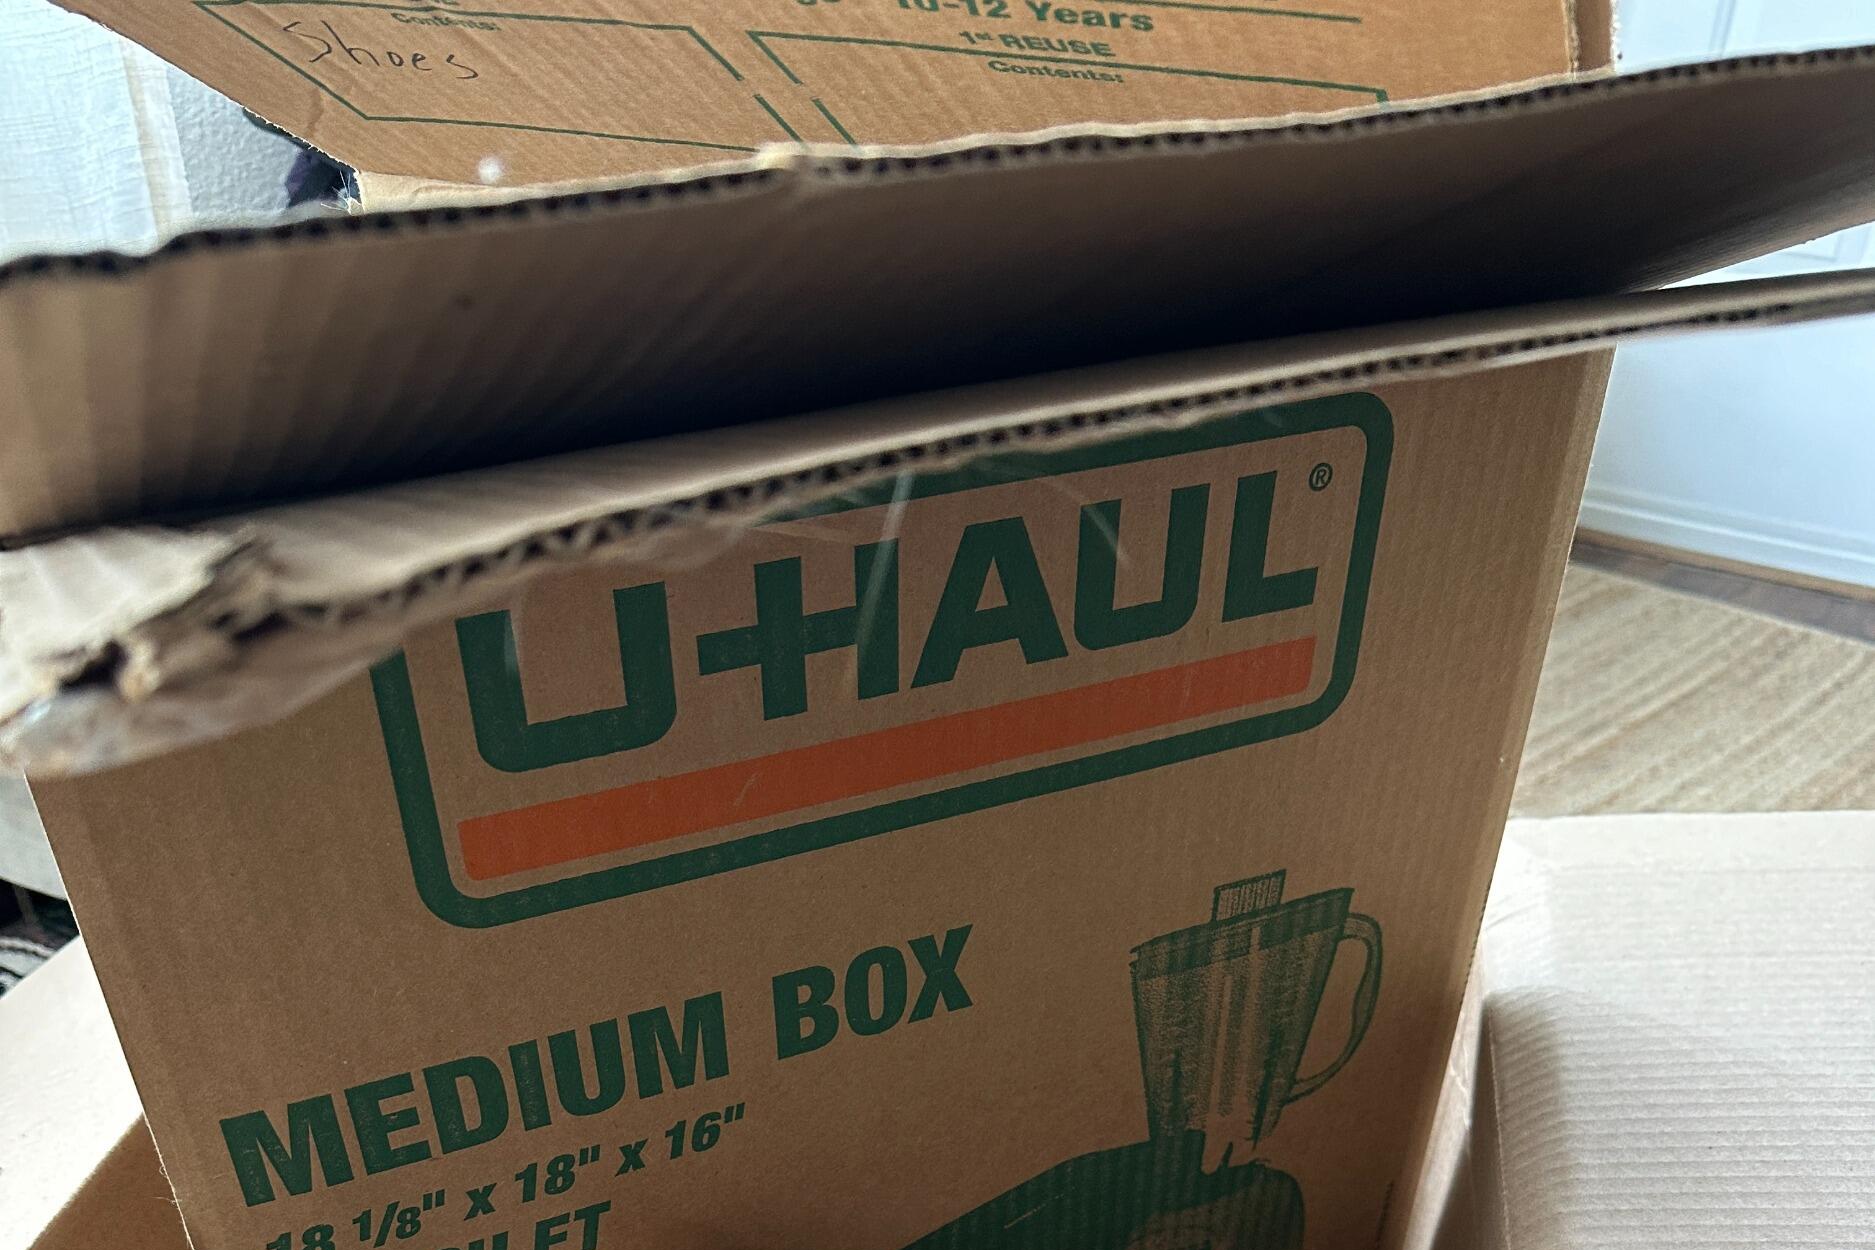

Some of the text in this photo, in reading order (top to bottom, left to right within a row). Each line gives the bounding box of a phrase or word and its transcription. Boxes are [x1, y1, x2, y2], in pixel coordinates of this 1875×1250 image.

[1027, 0, 1154, 31] Years
[282, 20, 479, 80] Shoes
[999, 33, 1116, 57] REUSE
[988, 60, 1124, 82] Contents:
[219, 924, 974, 1207] MEDIUM BOX
[352, 1190, 446, 1248] 1/8"
[464, 1183, 497, 1220] x
[515, 1144, 600, 1203] 18"
[615, 1138, 649, 1176] x
[665, 1102, 745, 1160] 16"
